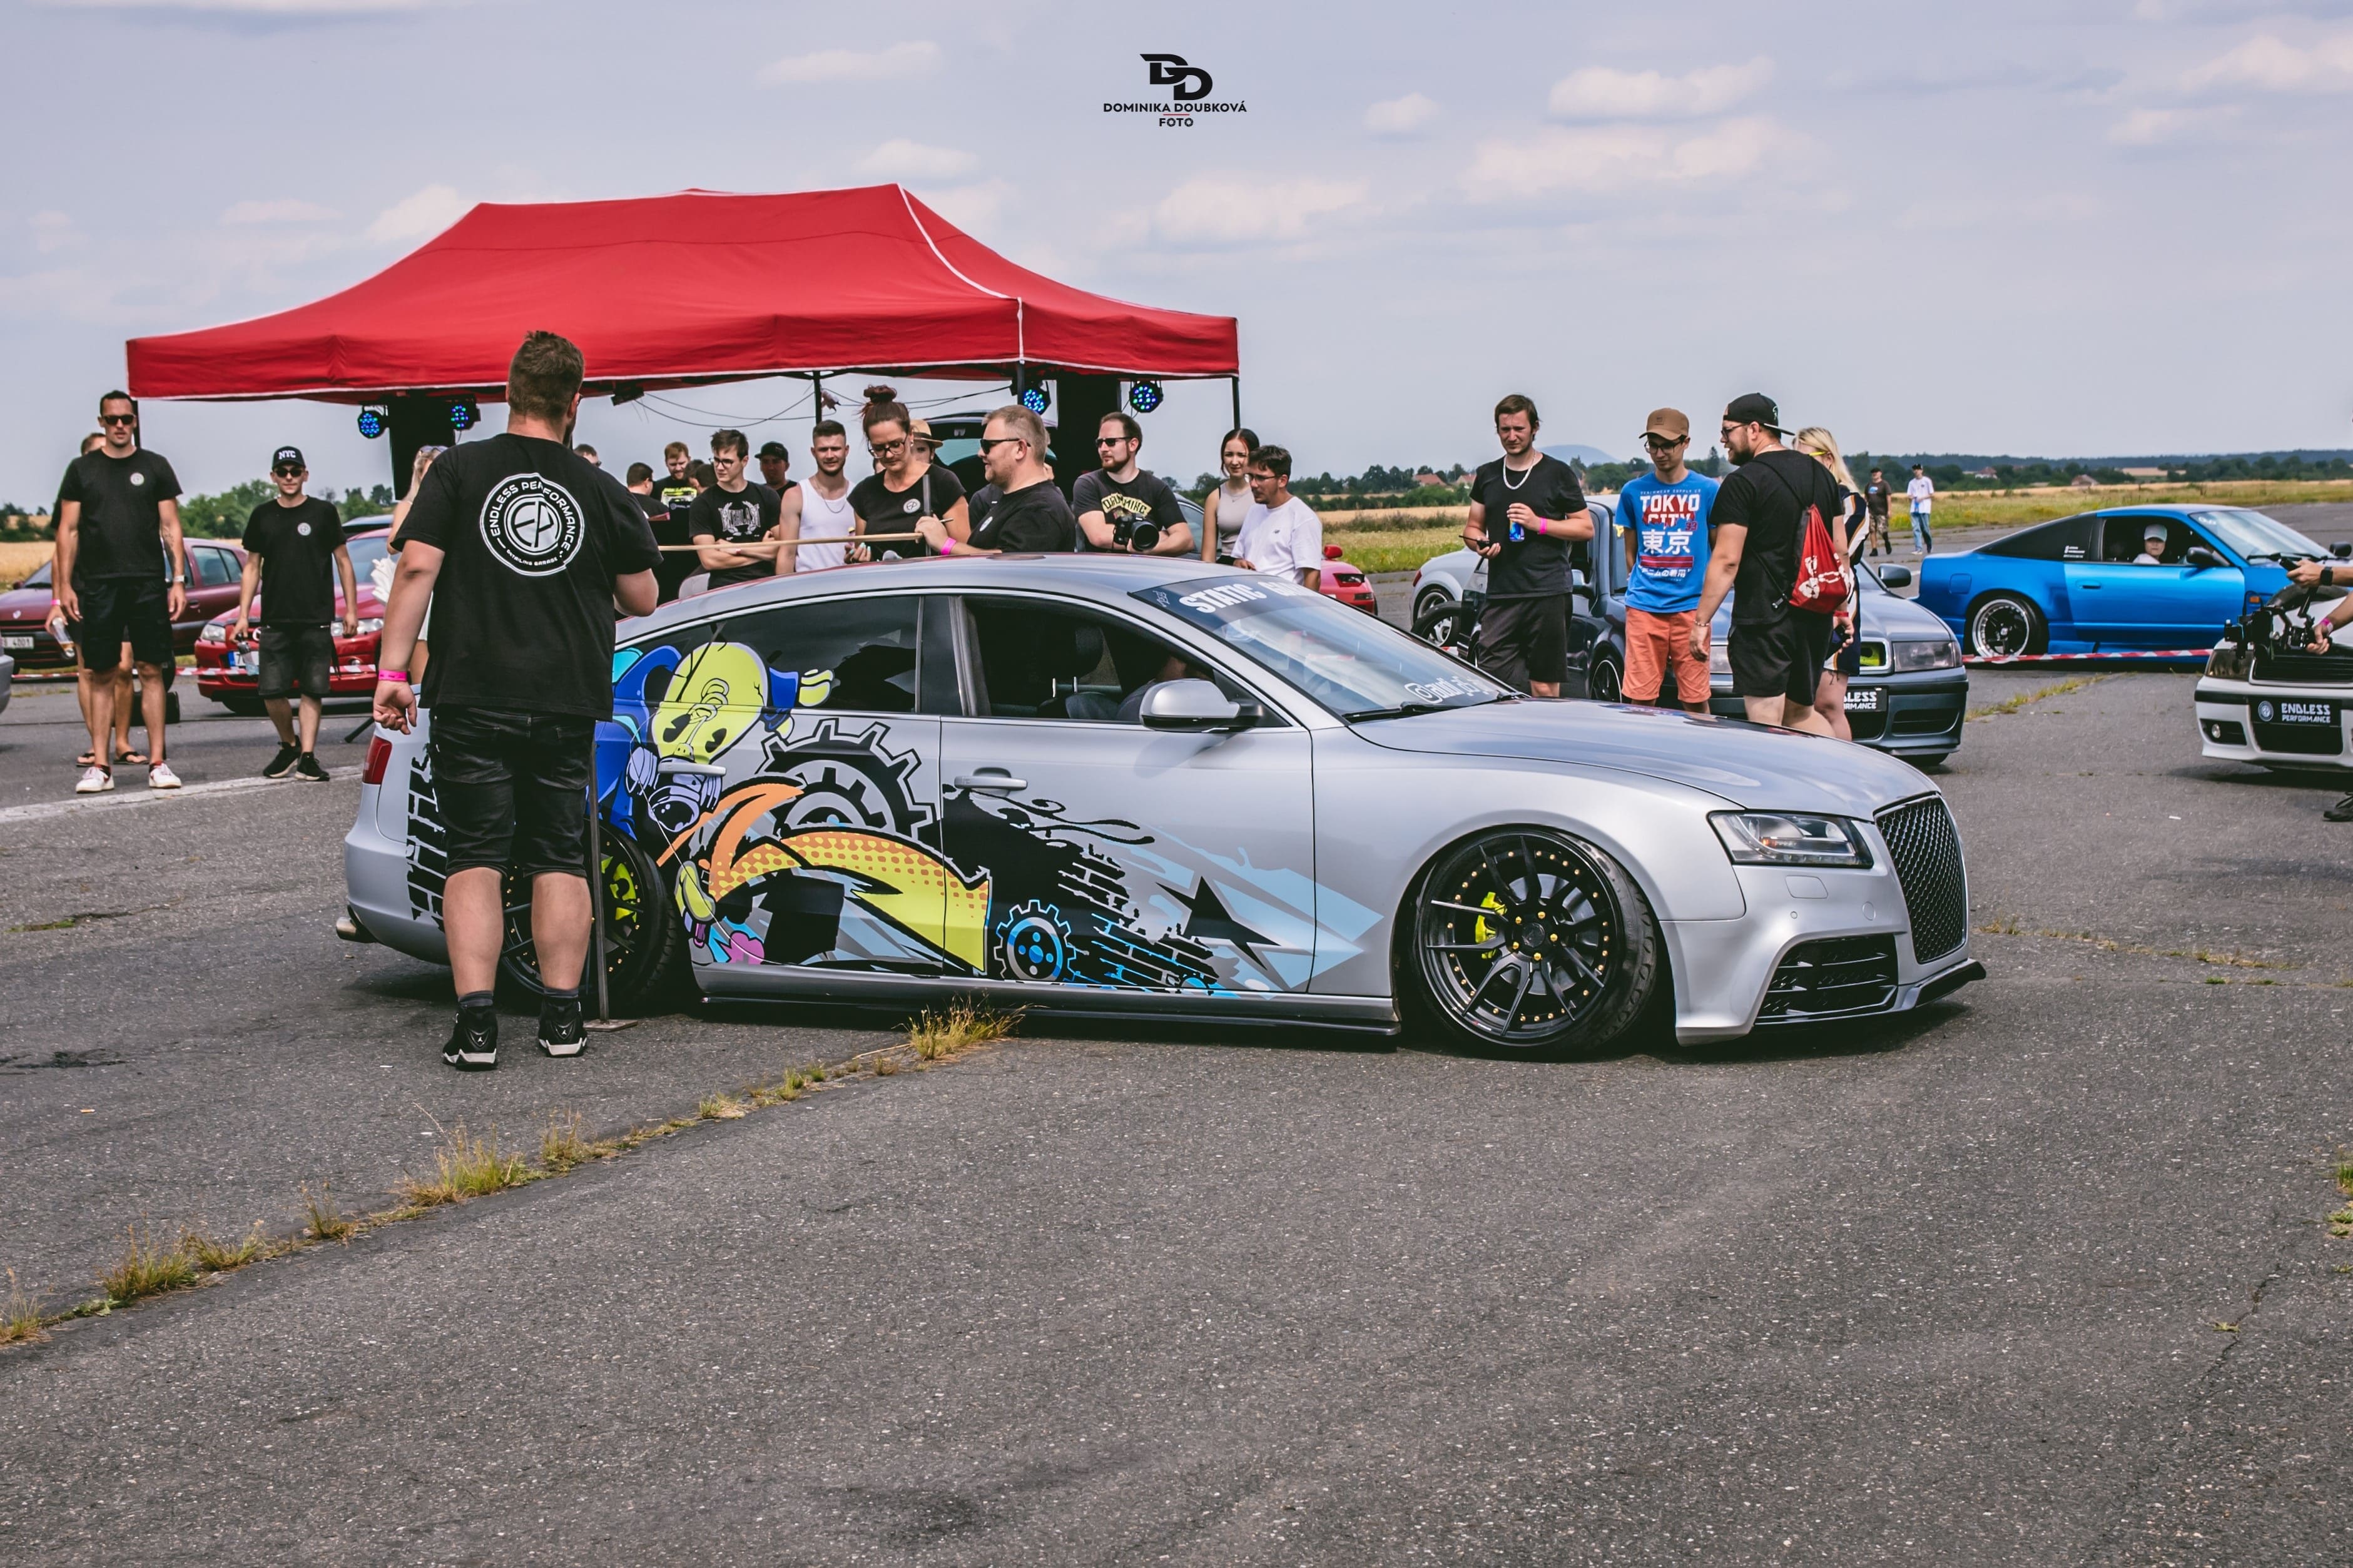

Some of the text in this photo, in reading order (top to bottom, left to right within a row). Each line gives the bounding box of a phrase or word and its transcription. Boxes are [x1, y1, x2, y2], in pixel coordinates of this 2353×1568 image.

[278, 450, 296, 460] NYC
[1640, 493, 1700, 512] TOKYO
[489, 480, 576, 551] ENDLESS PERFORMANCE
[1642, 528, 1694, 555] 東京
[534, 556, 559, 566] GARAGE
[1179, 584, 1268, 614] STATIC
[2281, 702, 2331, 716] ENDLESS
[2282, 714, 2331, 724] PERFORMANCE
